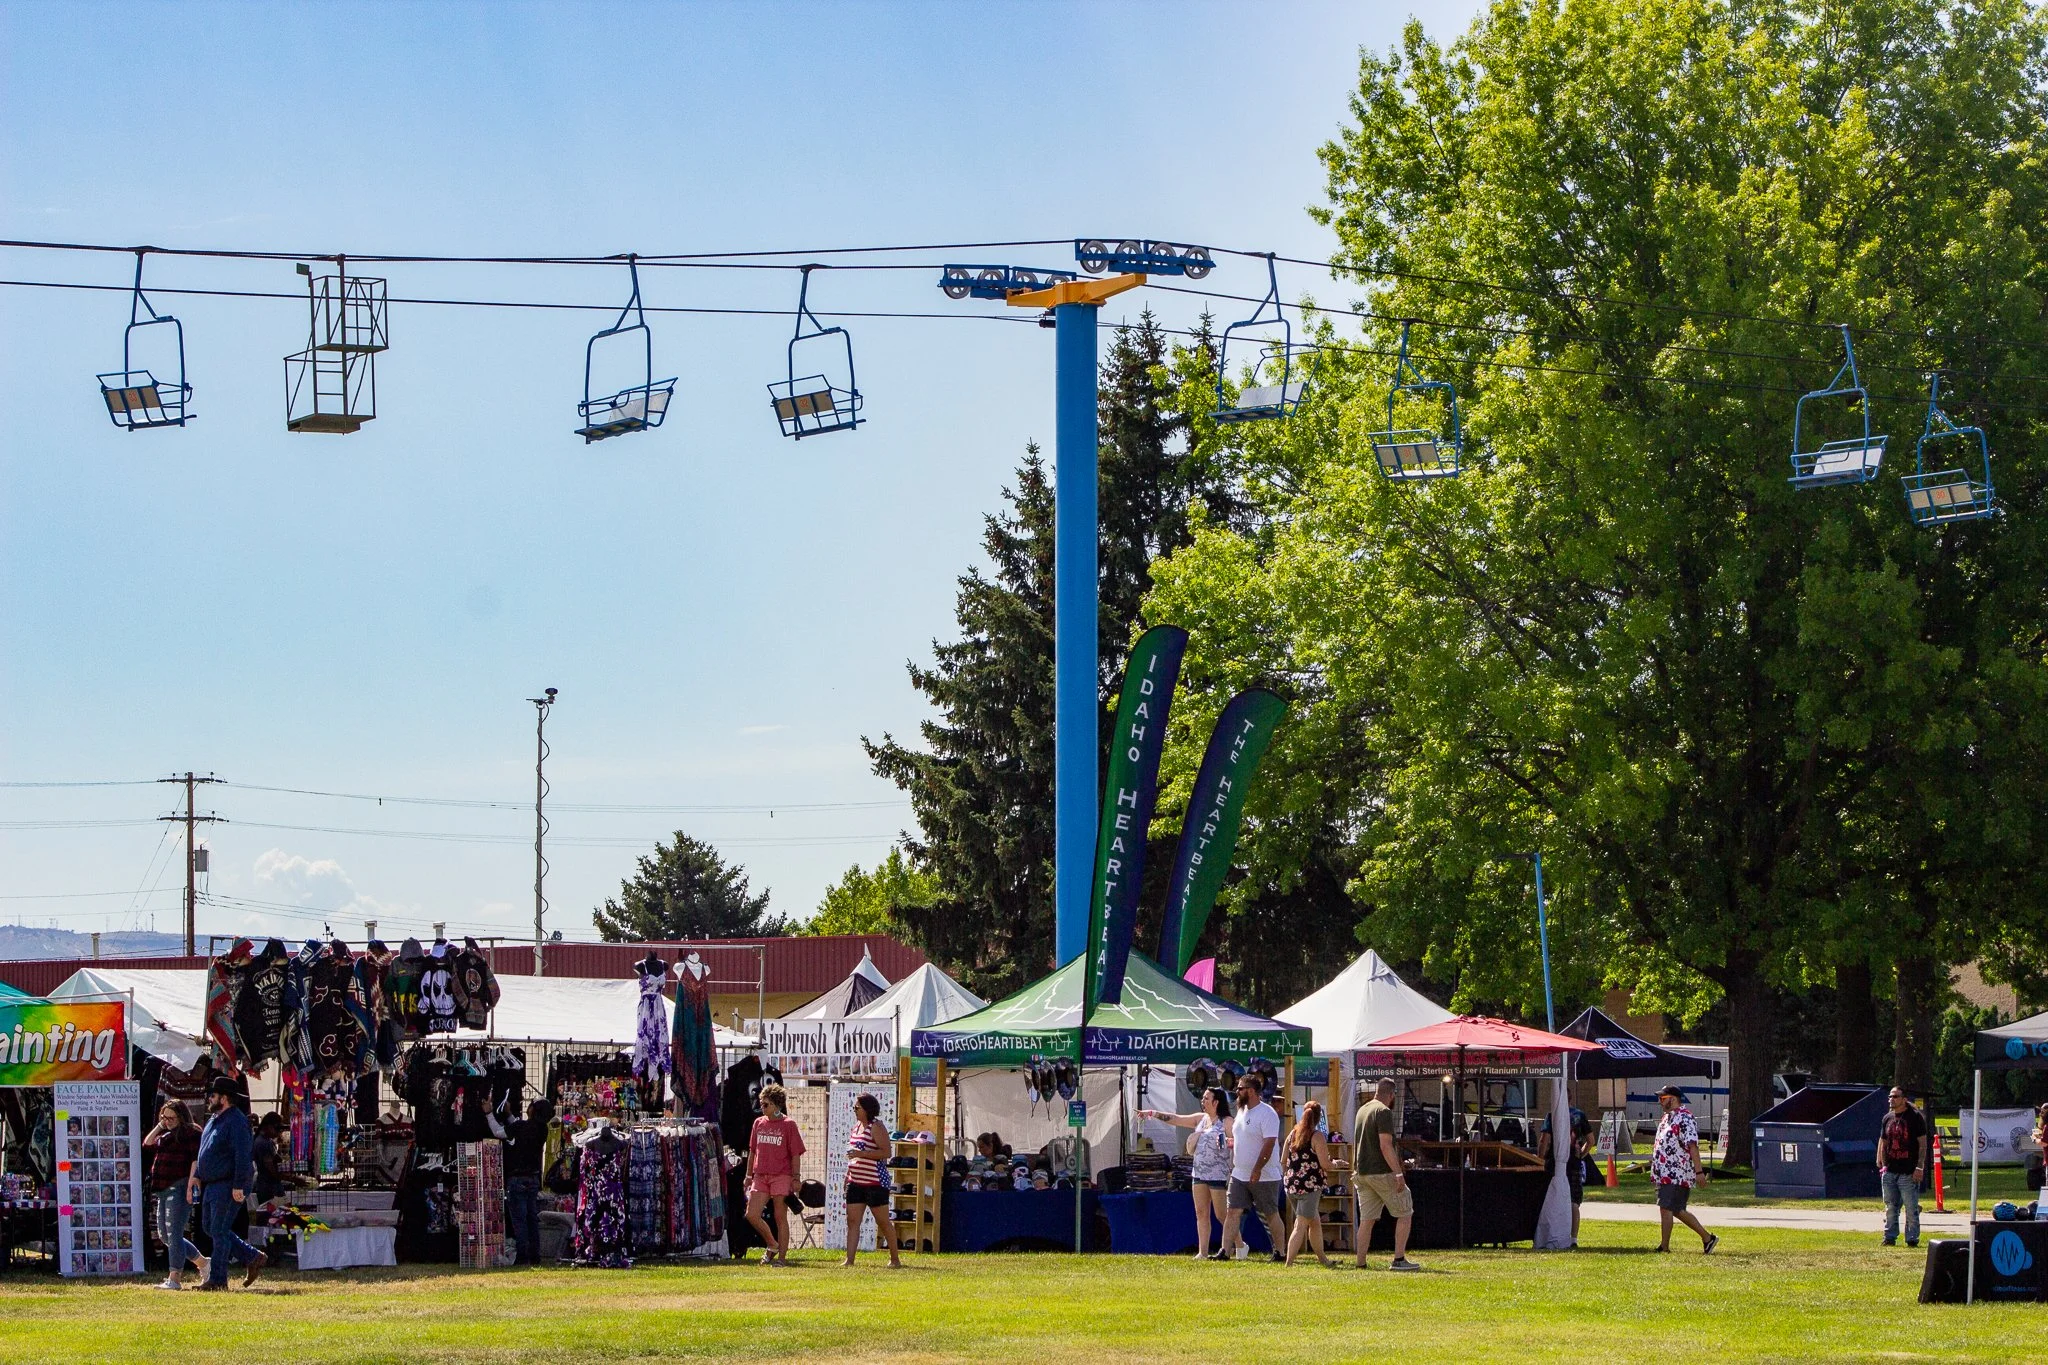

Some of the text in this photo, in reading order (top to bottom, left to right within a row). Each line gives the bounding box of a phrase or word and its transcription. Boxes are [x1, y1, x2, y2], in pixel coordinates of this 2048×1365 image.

[1095, 655, 1157, 977] IDAHO HEARTBEA
[1180, 718, 1255, 911] THE HEARTBEAT
[831, 1022, 891, 1054] Tattoos
[1598, 1040, 1643, 1050] POWER
[0, 1022, 116, 1069] ainting
[1357, 1052, 1395, 1066] RINGS
[1404, 1052, 1449, 1066] THUMB
[1451, 1052, 1488, 1066] RNGS
[1499, 1052, 1520, 1066] TOE
[1525, 1052, 1561, 1065] RINGS
[1357, 1067, 1395, 1076] Stainless
[1396, 1067, 1417, 1076] Steel
[1422, 1067, 1453, 1076] Sterling
[1454, 1067, 1478, 1075] Sver
[1484, 1067, 1519, 1075] Titanium
[1525, 1066, 1561, 1075] Tungsten
[56, 1084, 138, 1094] FACE PAINTING
[757, 1134, 783, 1146] WARNING
